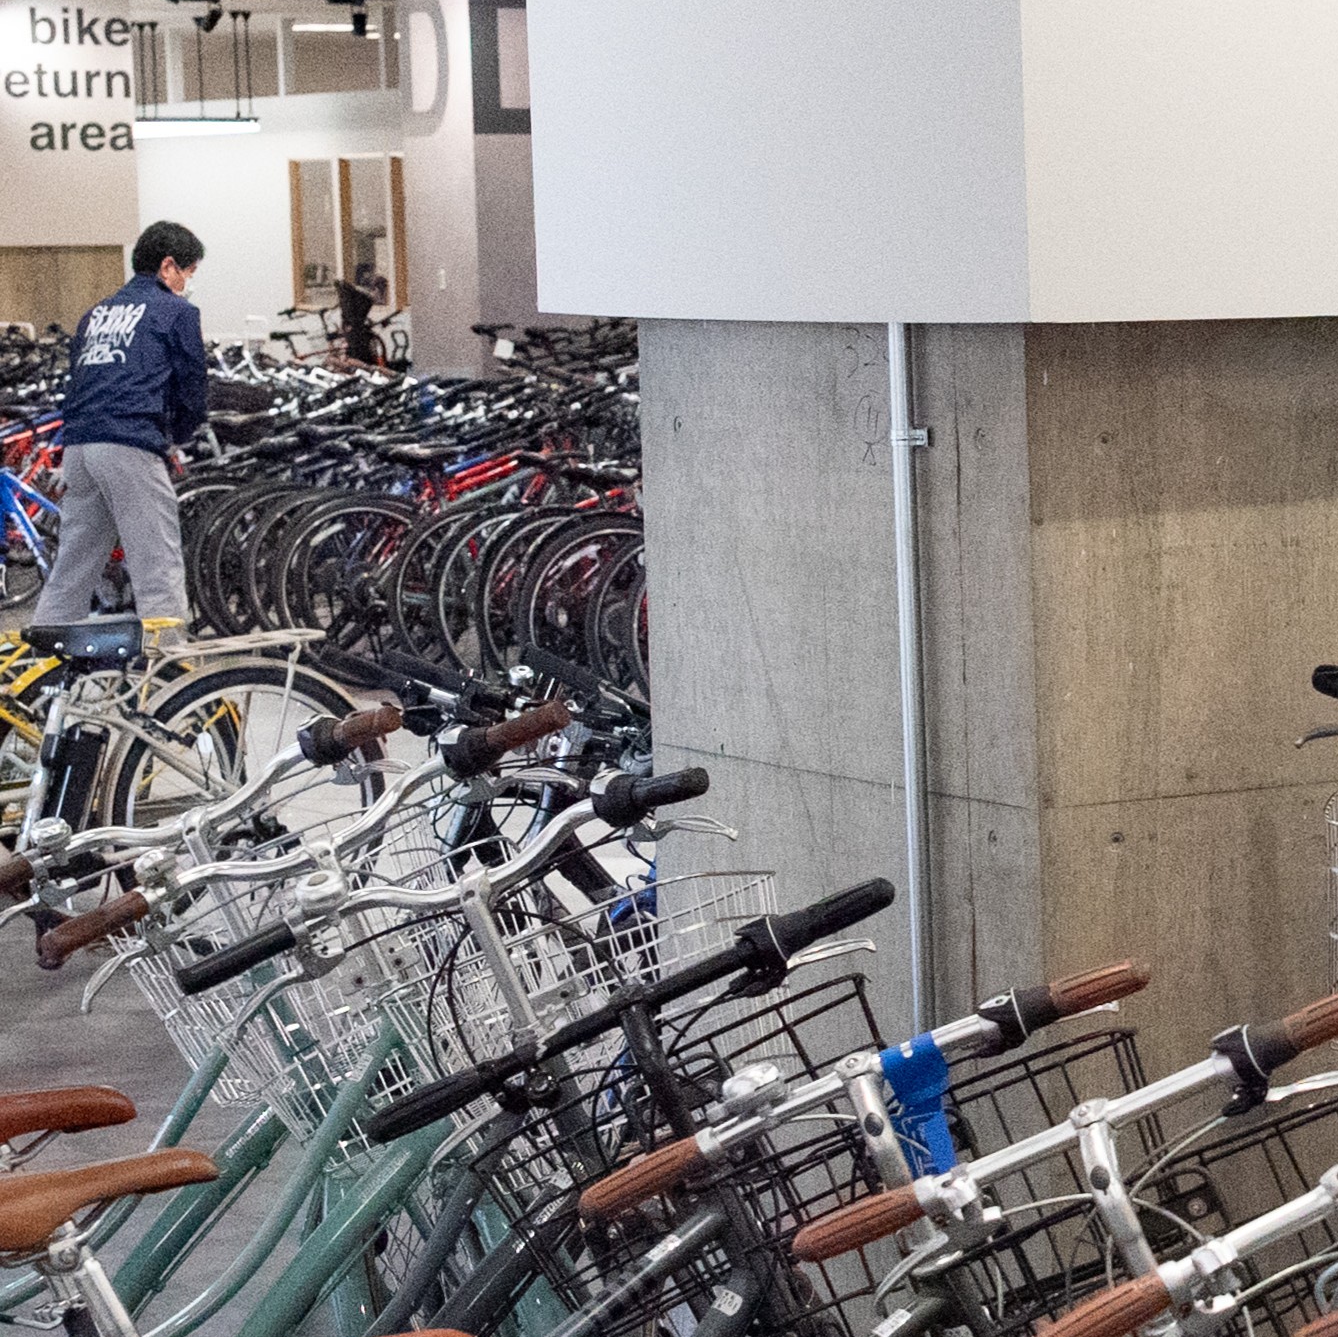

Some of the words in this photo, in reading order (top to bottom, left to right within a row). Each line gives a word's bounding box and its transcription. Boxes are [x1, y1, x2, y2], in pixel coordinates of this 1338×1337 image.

[29, 7, 130, 46] bike
[4, 63, 131, 98] eturn
[30, 121, 134, 151] area
